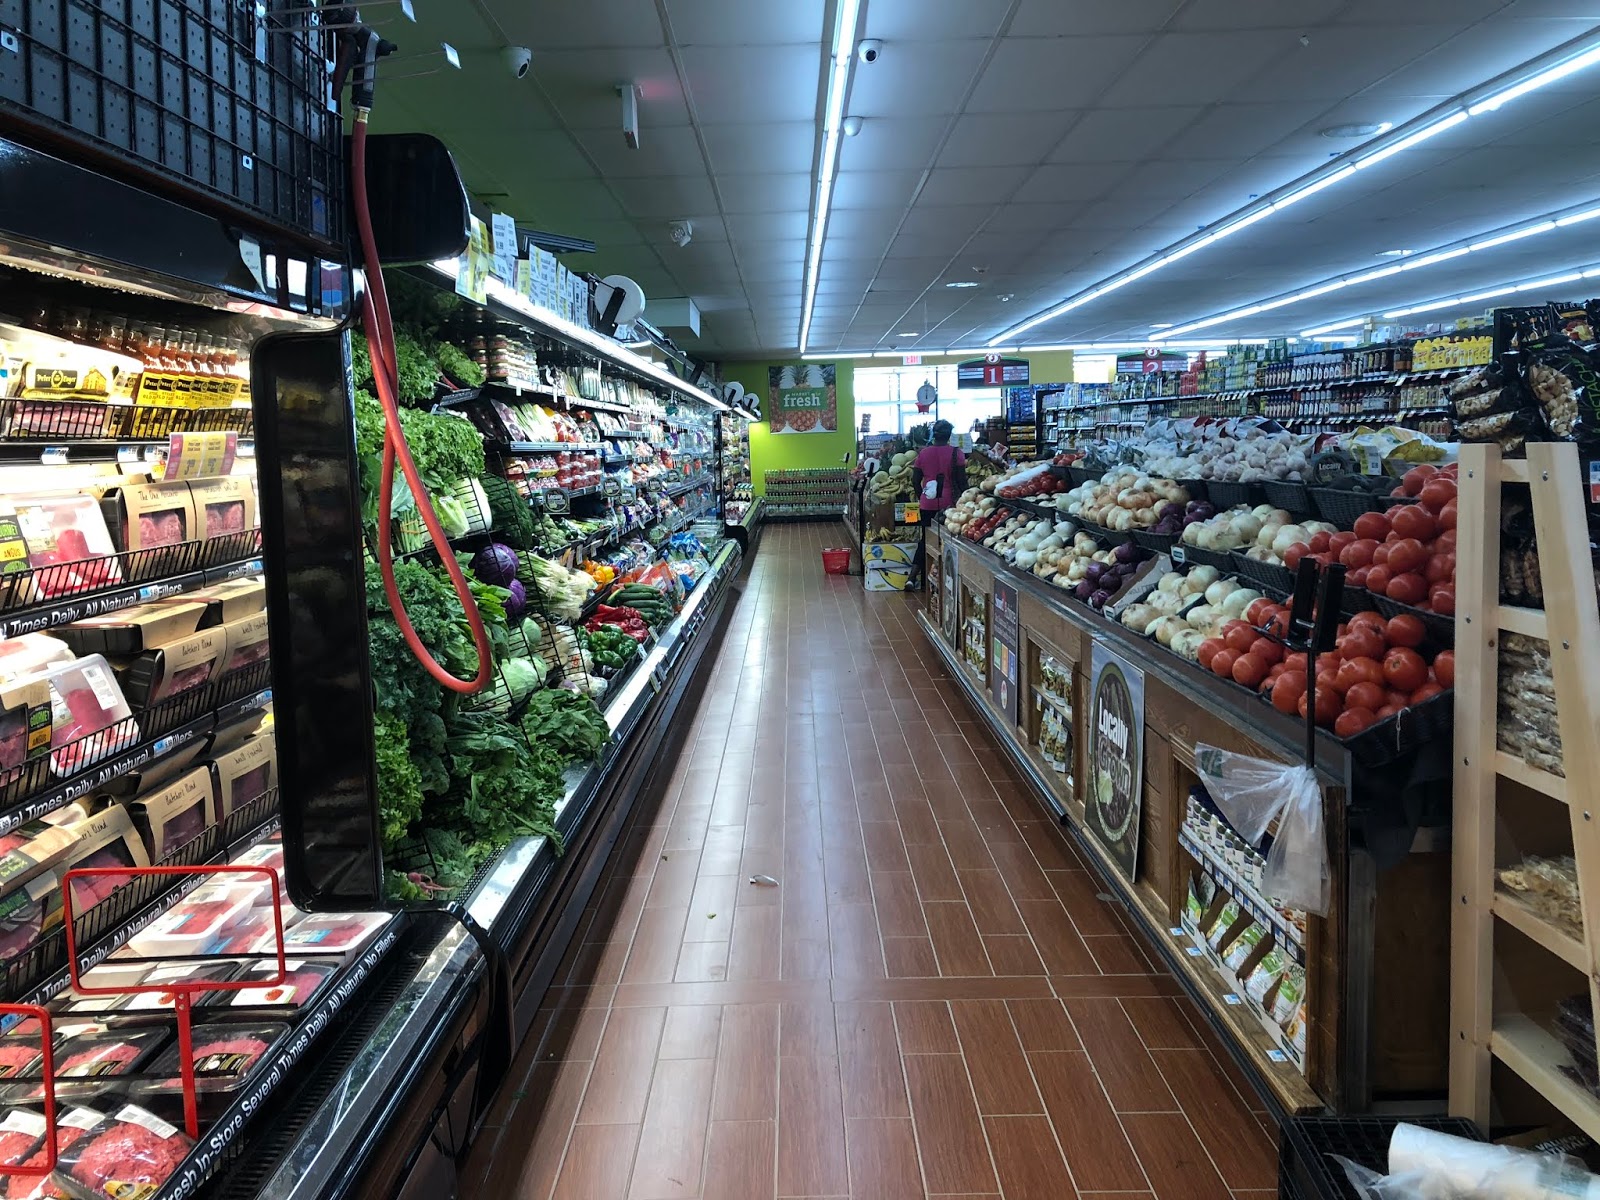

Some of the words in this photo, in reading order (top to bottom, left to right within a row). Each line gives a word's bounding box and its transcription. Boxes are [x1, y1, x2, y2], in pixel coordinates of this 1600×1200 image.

[783, 393, 821, 407] fresh
[988, 367, 998, 384] 1
[10, 616, 48, 636] Times
[50, 608, 81, 627] Daily.
[85, 602, 99, 616] All
[100, 592, 139, 613] Natural.
[1098, 697, 1129, 761] Locally
[25, 795, 63, 820] Times
[65, 780, 94, 799] Daily.
[98, 769, 112, 785] All
[113, 750, 151, 776] Natural.
[42, 973, 72, 1000] Time
[80, 944, 110, 973] Daily.
[112, 929, 126, 949] All
[127, 903, 164, 938] Natural.
[165, 892, 180, 909] No
[162, 1168, 197, 1200] resh
[195, 1114, 243, 1174] In-Store
[241, 1065, 281, 1118] Several
[278, 1034, 309, 1071] Times
[304, 1009, 331, 1038] Daily.
[327, 992, 341, 1014] All
[337, 963, 368, 1001] Natural.
[364, 952, 378, 969] No
[374, 931, 397, 958] Fillers.
